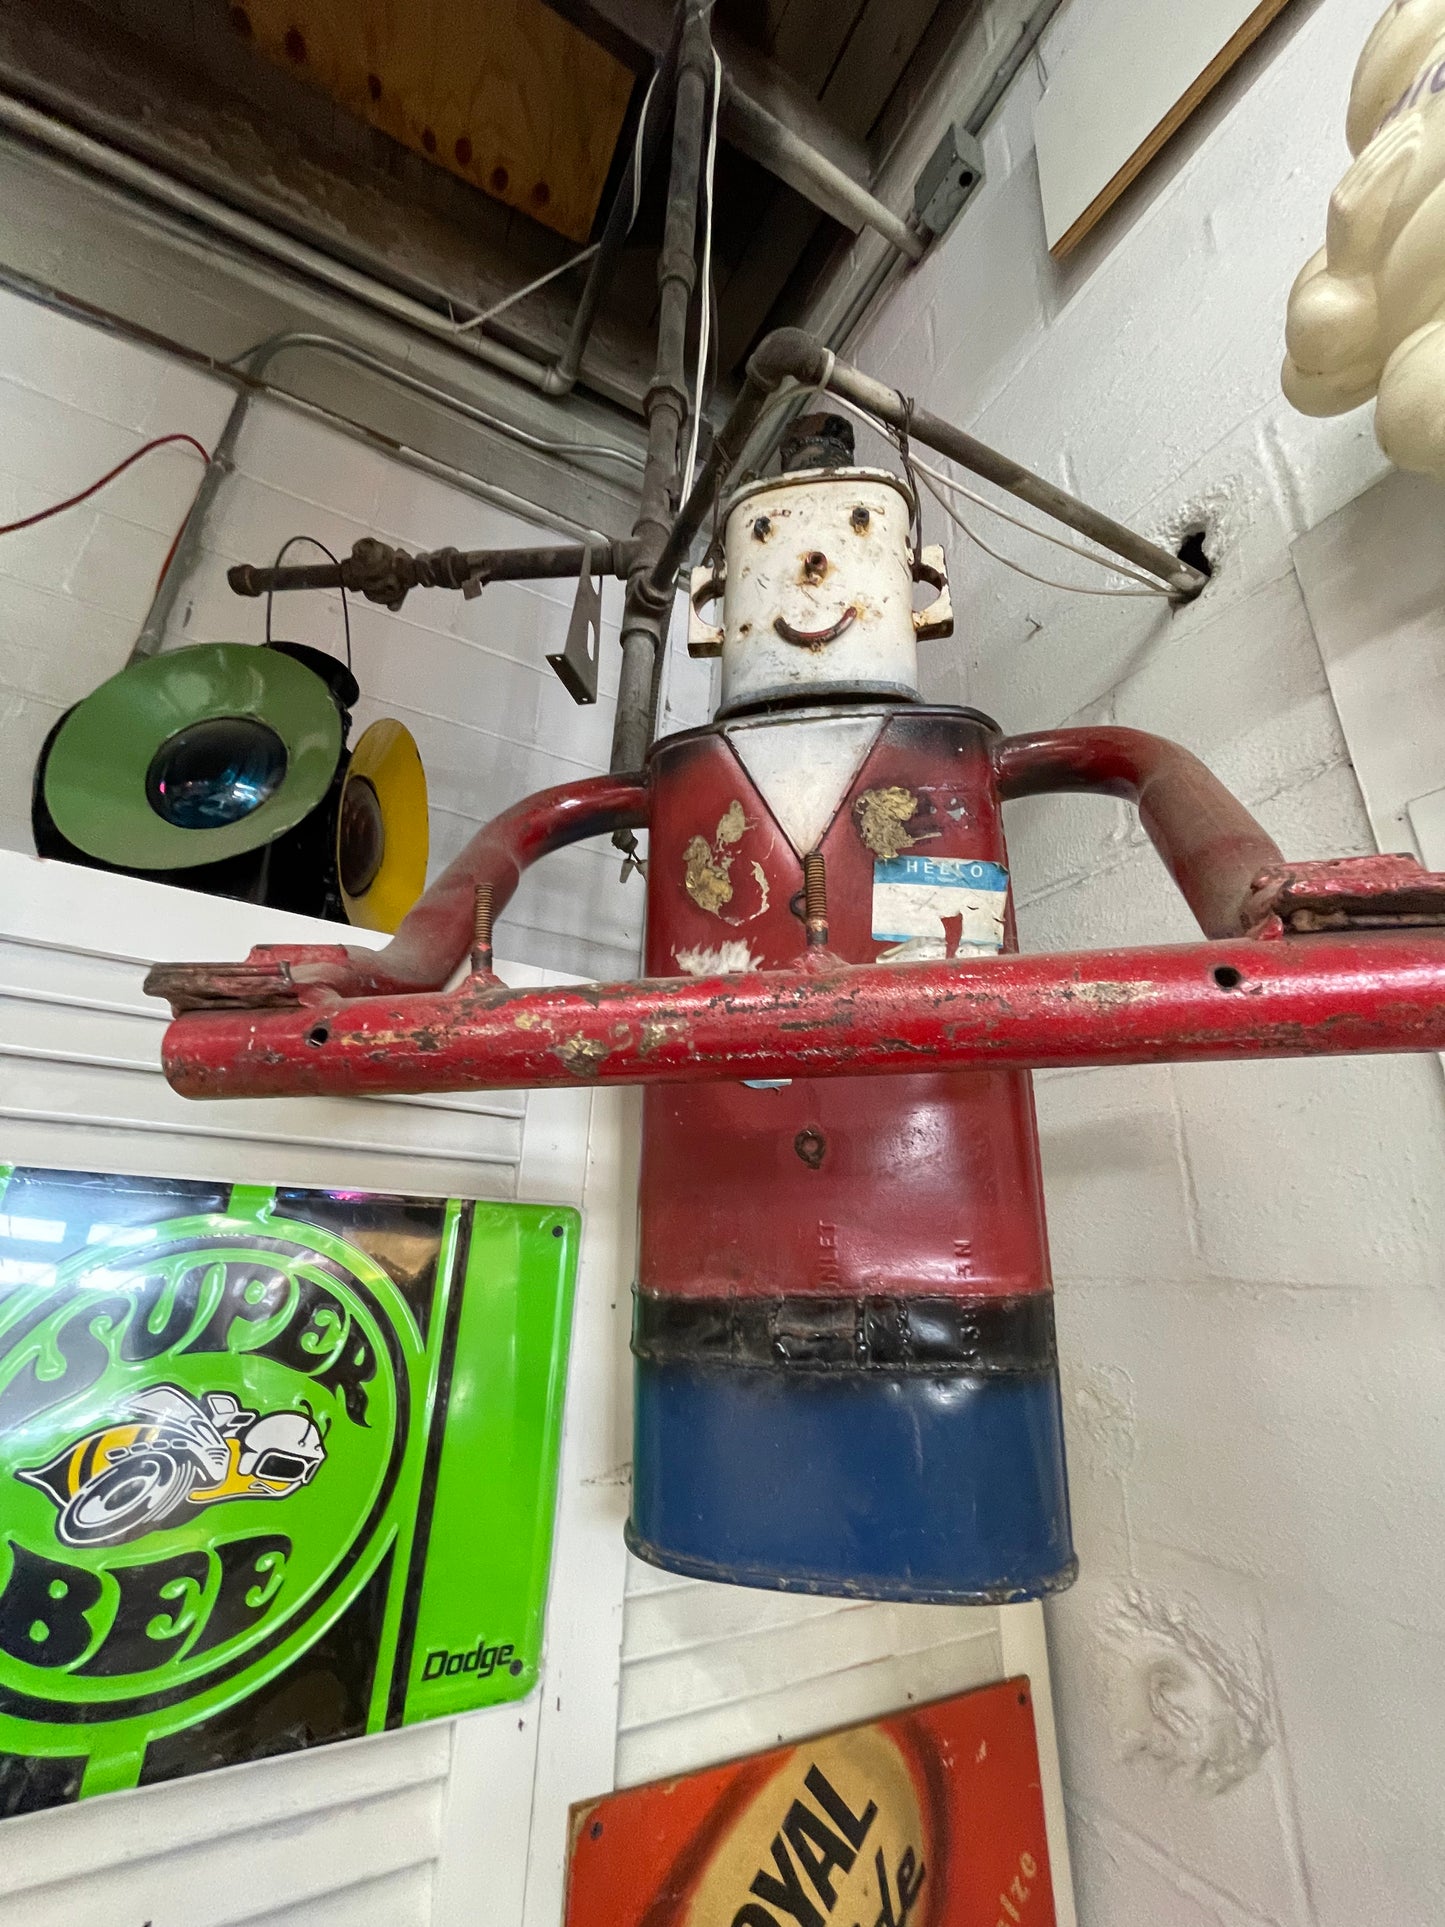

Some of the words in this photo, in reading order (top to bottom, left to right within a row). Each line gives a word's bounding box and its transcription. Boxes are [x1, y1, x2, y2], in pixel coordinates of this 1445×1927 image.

[0, 1262, 376, 1430] SUPER
[0, 1534, 293, 1678] BEE
[420, 1641, 516, 1682] Dodge
